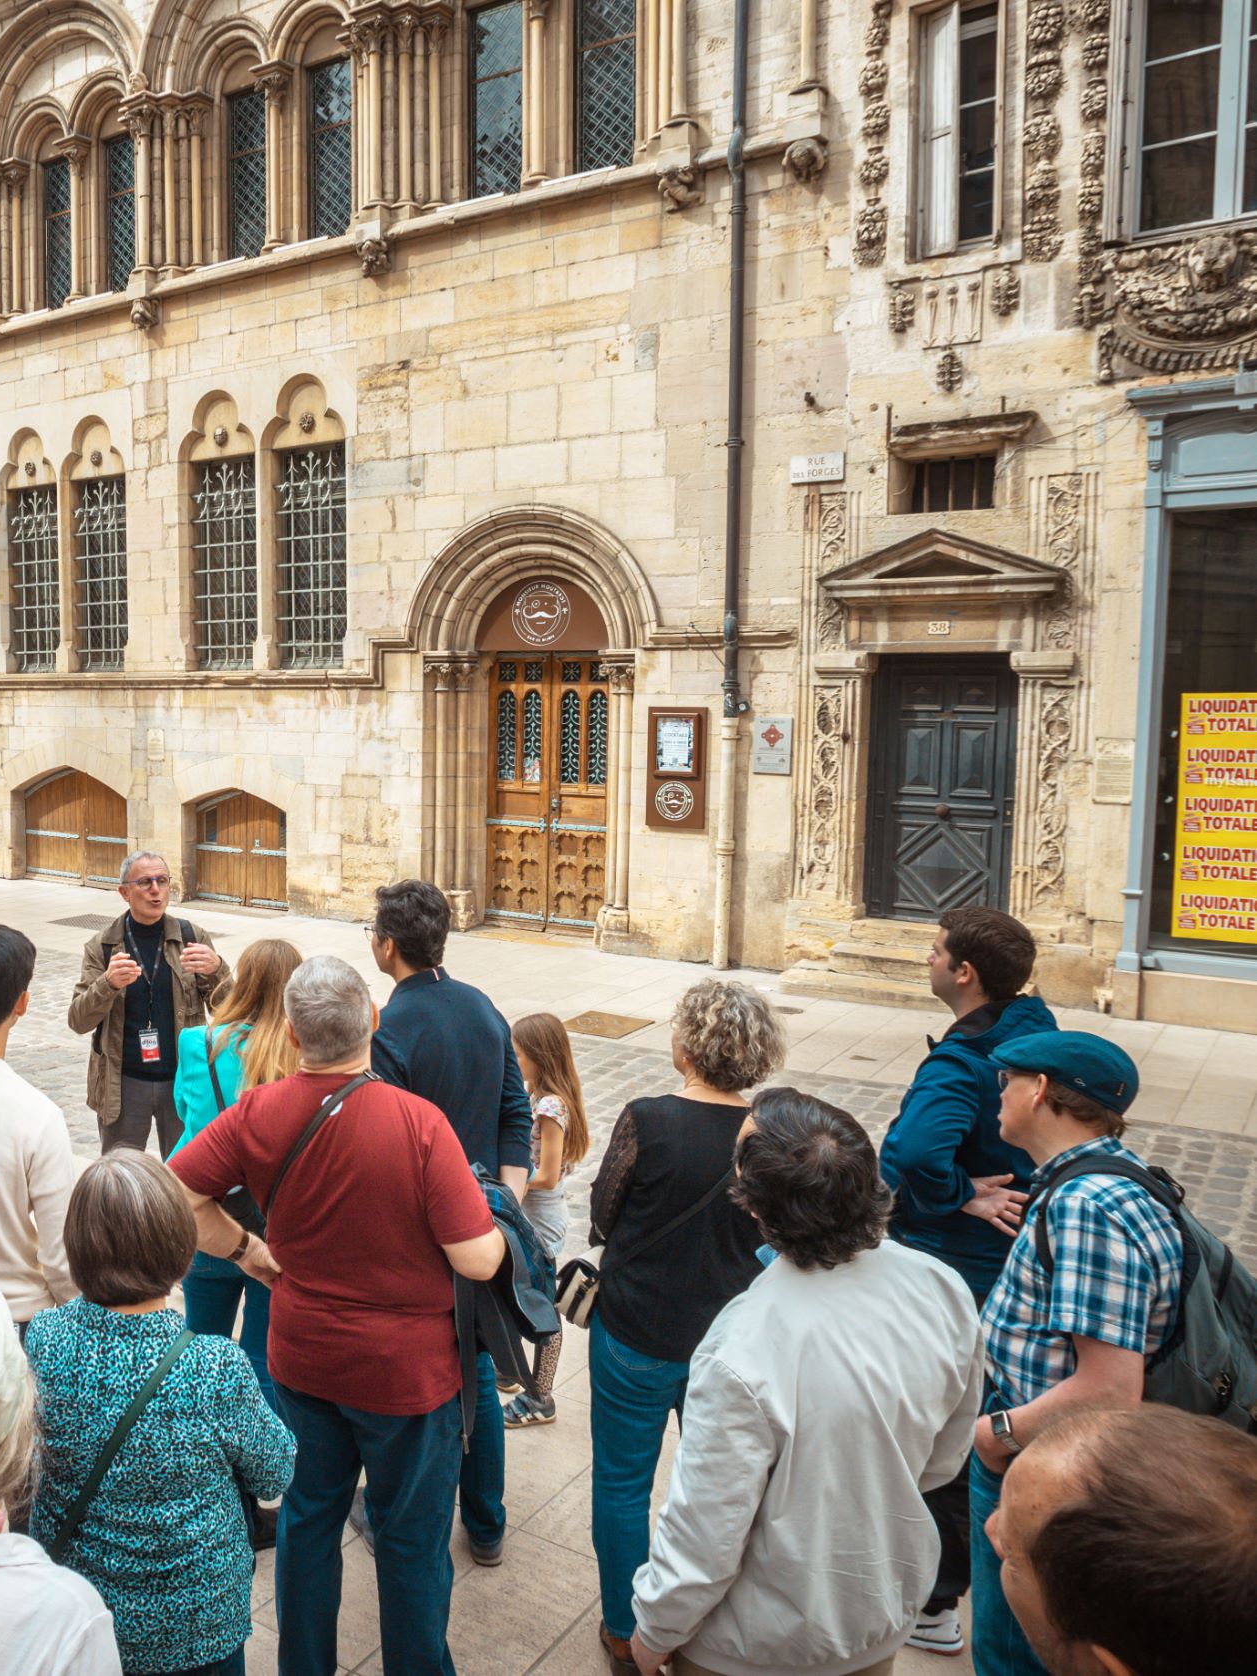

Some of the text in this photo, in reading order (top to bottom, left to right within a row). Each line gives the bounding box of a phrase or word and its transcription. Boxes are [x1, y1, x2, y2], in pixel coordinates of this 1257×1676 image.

[807, 456, 826, 466] RUE
[806, 467, 841, 478] FORGES
[1207, 718, 1257, 732] TOTAL
[1187, 749, 1257, 764] LIQUIDAT
[1203, 816, 1257, 832] TOTALE
[1201, 865, 1257, 881] TOTALE
[1198, 913, 1256, 931] TOTALE
